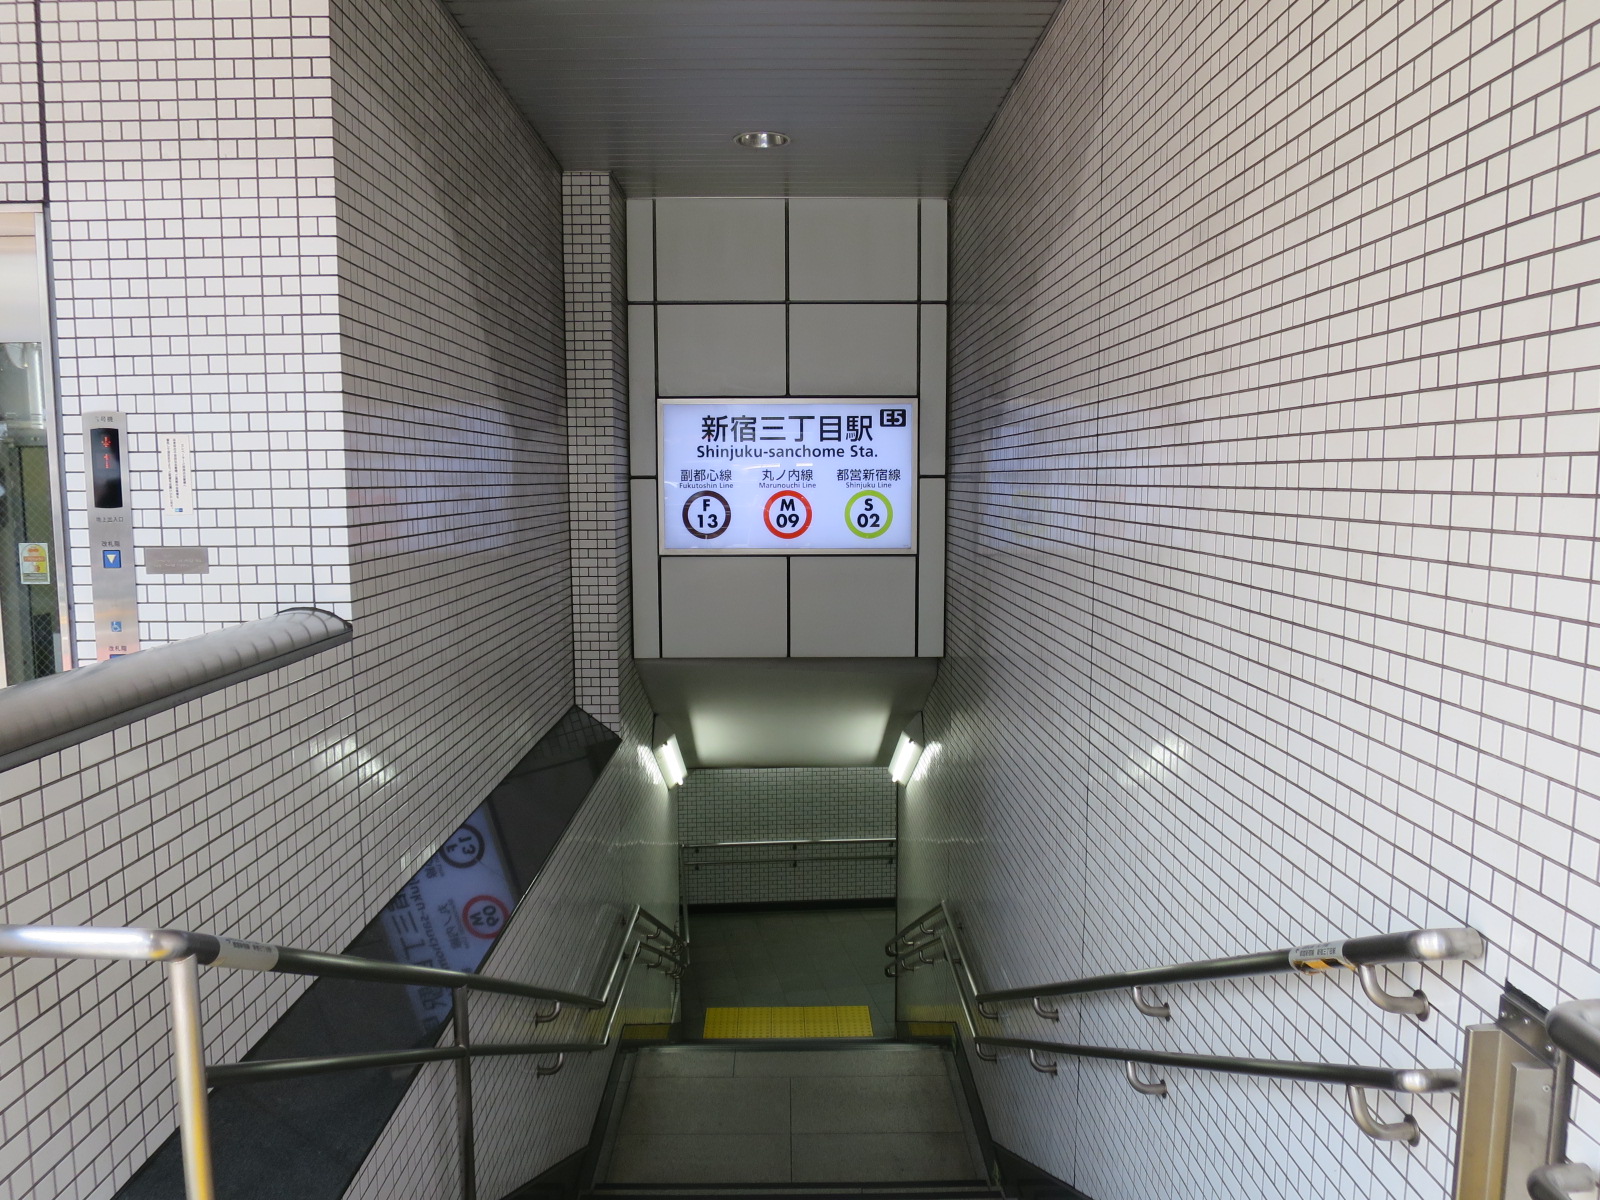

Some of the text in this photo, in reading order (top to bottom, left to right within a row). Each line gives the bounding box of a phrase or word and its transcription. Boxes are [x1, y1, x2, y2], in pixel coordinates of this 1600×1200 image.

[883, 410, 903, 426] E5
[701, 415, 873, 442] 新宿三丁目駅
[697, 445, 878, 461] Shinjuku-sanchome Sta.
[680, 469, 732, 482] 副都心線
[762, 469, 813, 482] 丸ノ内線
[836, 469, 901, 482] 都営新宿線
[846, 482, 876, 490] Shinjuku
[703, 499, 711, 512] F
[780, 499, 796, 512] M
[864, 498, 874, 512] S
[697, 514, 718, 528] 13
[776, 513, 800, 528] 09
[857, 513, 880, 528] 02
